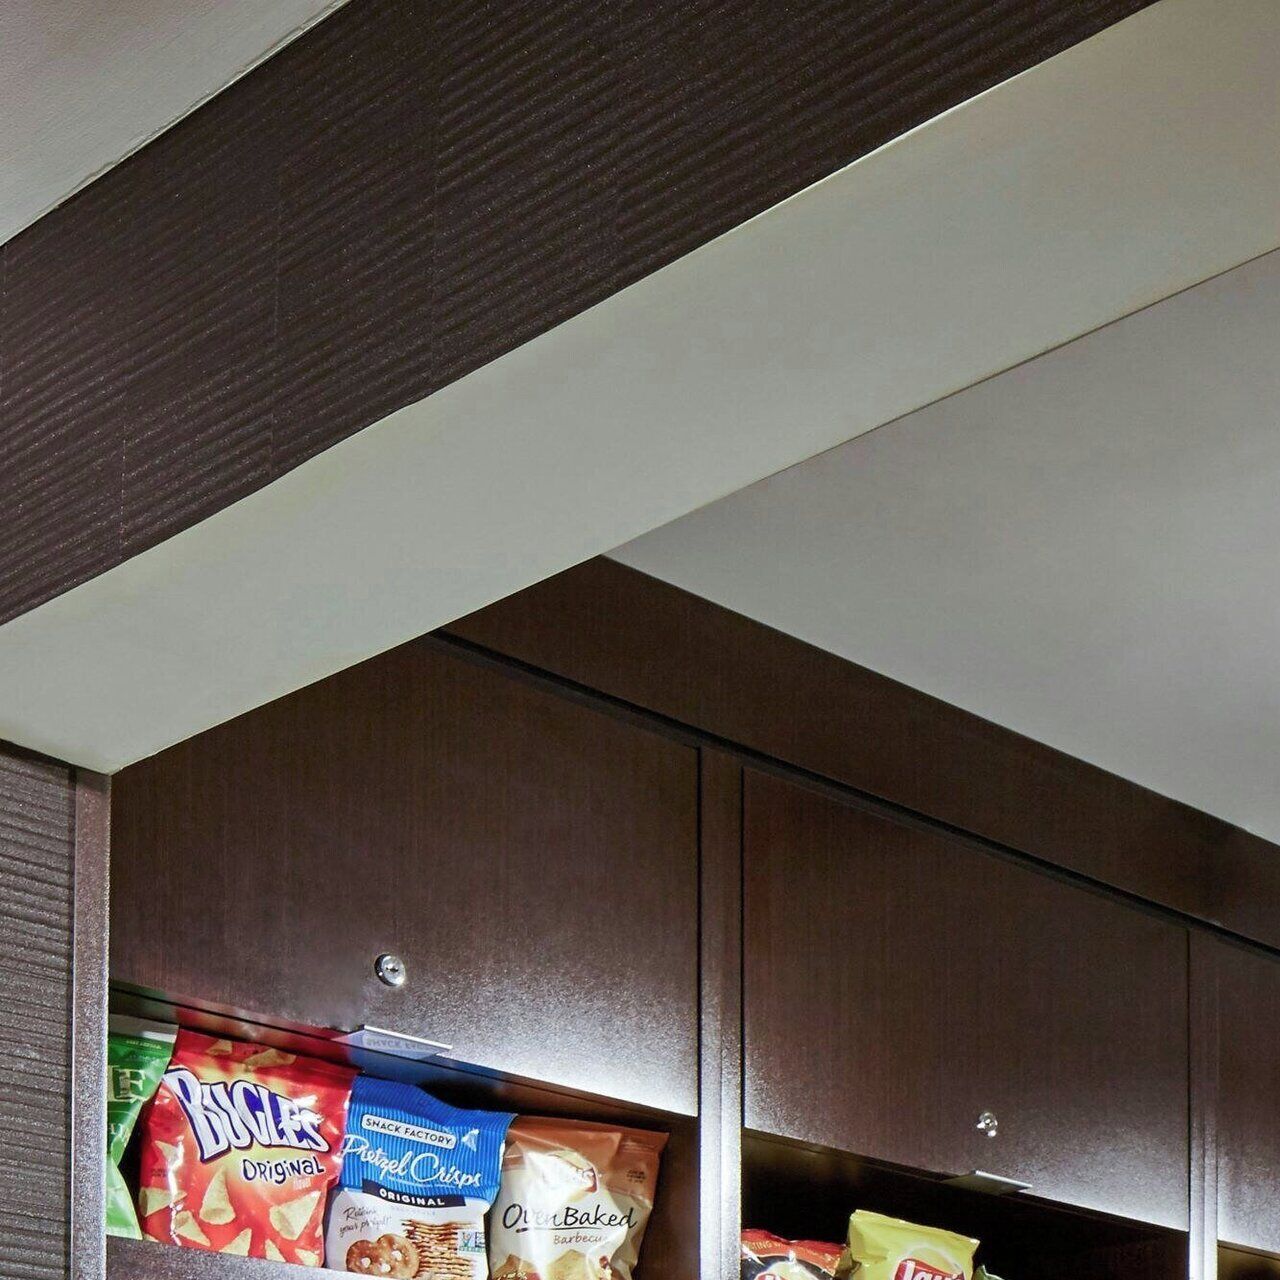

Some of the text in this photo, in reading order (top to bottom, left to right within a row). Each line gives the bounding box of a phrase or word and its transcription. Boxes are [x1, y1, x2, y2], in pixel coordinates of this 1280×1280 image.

[162, 1066, 329, 1163] BUGLES
[365, 1117, 453, 1145] SNACK FACTORY
[344, 1135, 482, 1188] Pretzel Crisps
[379, 1188, 445, 1206] ORIGINAL
[564, 1204, 637, 1229] Baked
